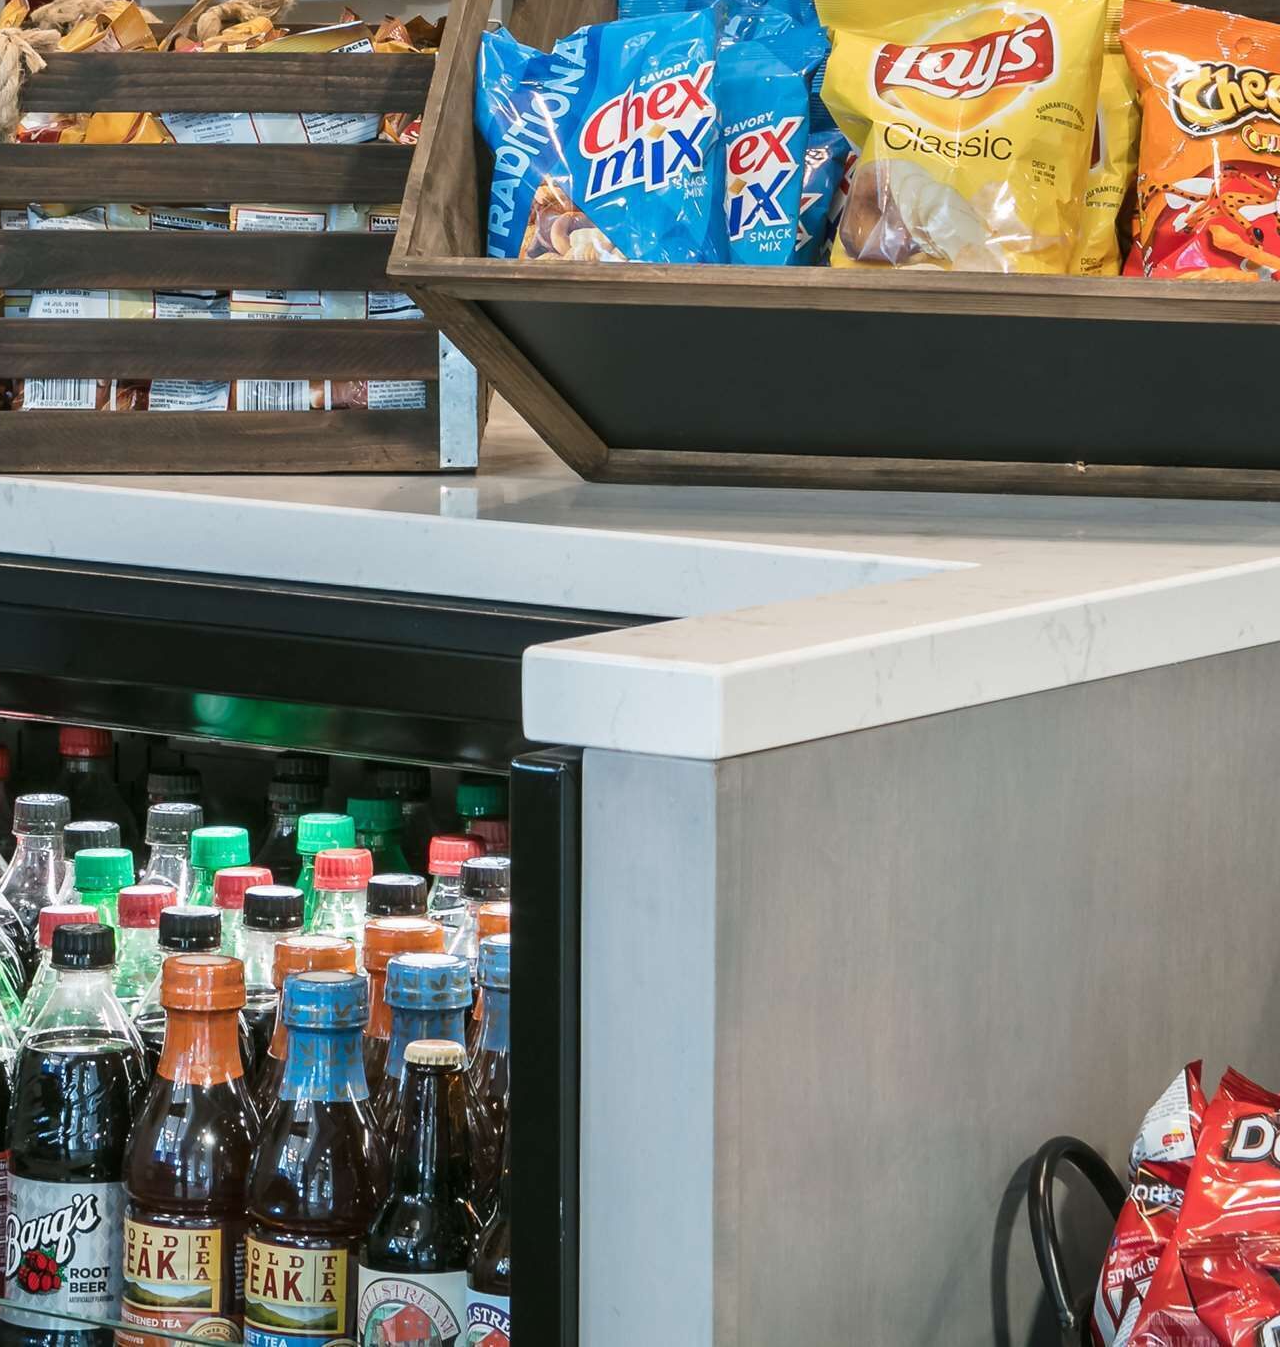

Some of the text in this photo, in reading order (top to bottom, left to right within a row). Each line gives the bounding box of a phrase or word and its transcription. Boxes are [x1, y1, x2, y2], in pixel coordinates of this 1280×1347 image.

[639, 58, 691, 87] SAVORY
[883, 24, 1047, 100] Lay's
[582, 64, 713, 155] Chex
[723, 110, 774, 138] SAVORY
[883, 122, 1014, 161] Classic
[588, 115, 712, 198] mix
[1032, 159, 1046, 170] DEC
[676, 173, 709, 191] SNACK
[684, 186, 704, 199] MIX
[749, 228, 792, 243] SNACK
[759, 239, 781, 252] MIX
[5, 1191, 102, 1280] Barq's
[194, 1235, 212, 1281] TEA
[70, 1266, 111, 1279] ROOT
[322, 1255, 338, 1303] TEA
[70, 1281, 106, 1294] BEER
[161, 1317, 182, 1329] TEA
[359, 1284, 456, 1336] MILLSTREAM
[264, 1335, 288, 1347] TEA
